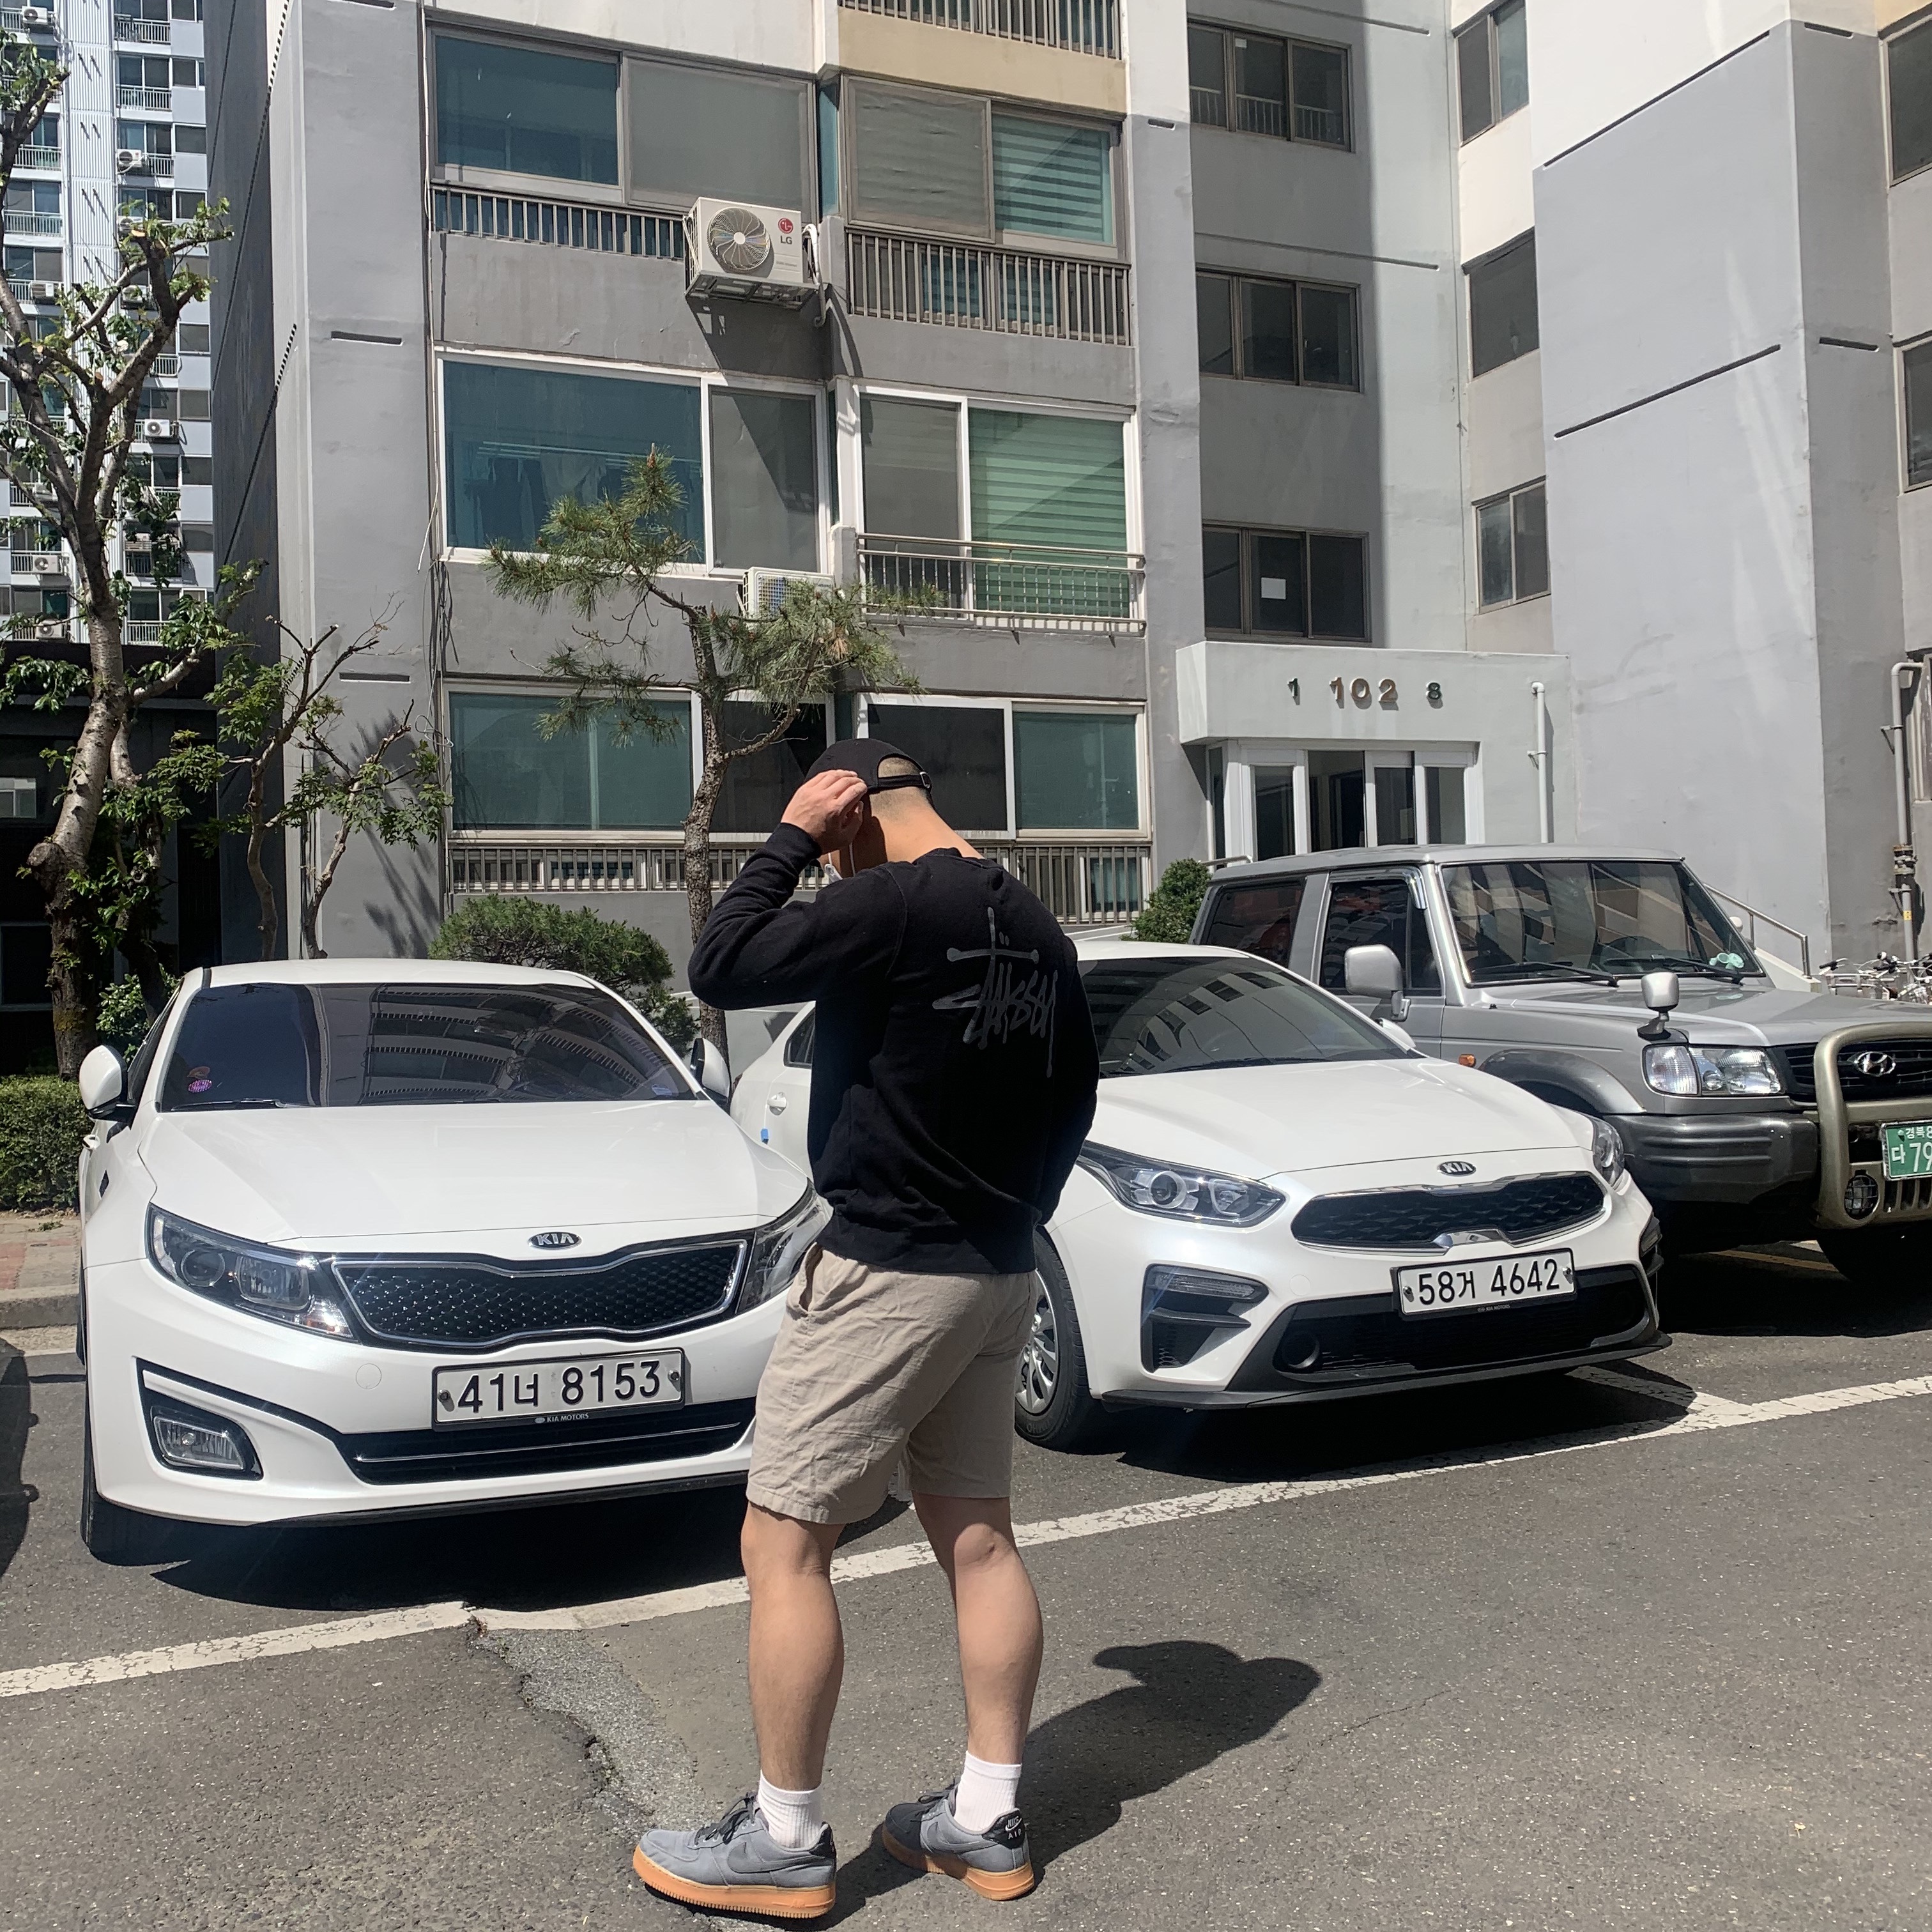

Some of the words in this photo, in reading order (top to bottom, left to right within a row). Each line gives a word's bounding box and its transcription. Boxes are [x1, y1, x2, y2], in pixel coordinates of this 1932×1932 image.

[780, 236, 792, 245] LG
[1287, 678, 1298, 697] 1
[1329, 677, 1397, 702] 102
[1426, 682, 1442, 700] 8
[1441, 1162, 1473, 1173] KIA
[536, 1233, 575, 1246] KIA
[1418, 1271, 1475, 1305] 58거
[1491, 1258, 1560, 1296] 4642
[457, 1373, 539, 1413] 41너
[562, 1360, 660, 1405] 8153
[560, 1413, 589, 1422] MOTORS
[1008, 1828, 1022, 1840] AIR
